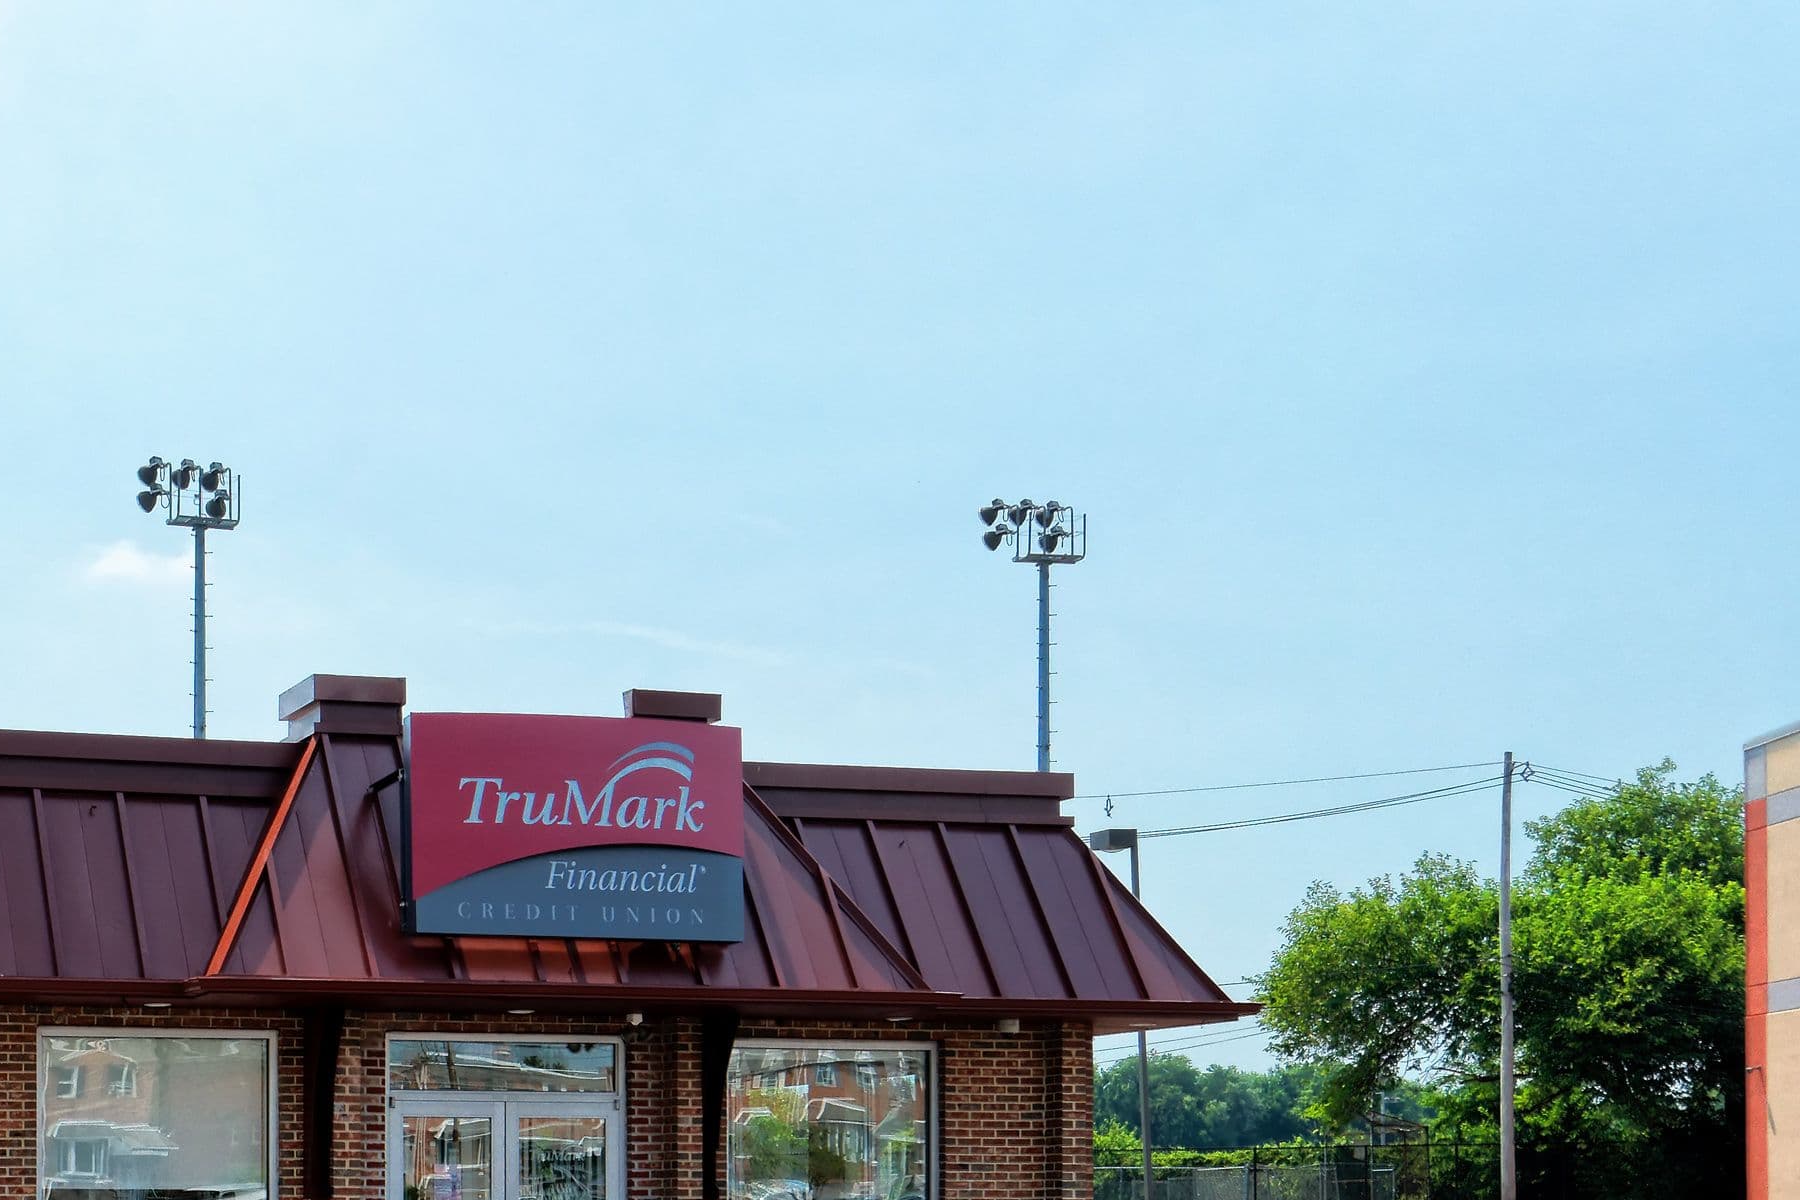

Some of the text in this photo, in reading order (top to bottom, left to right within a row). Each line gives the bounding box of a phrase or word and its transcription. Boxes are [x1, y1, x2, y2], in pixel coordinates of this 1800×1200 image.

[458, 776, 705, 832] TruMark
[545, 860, 697, 893] Financial
[458, 900, 704, 924] CREDIT UNION
